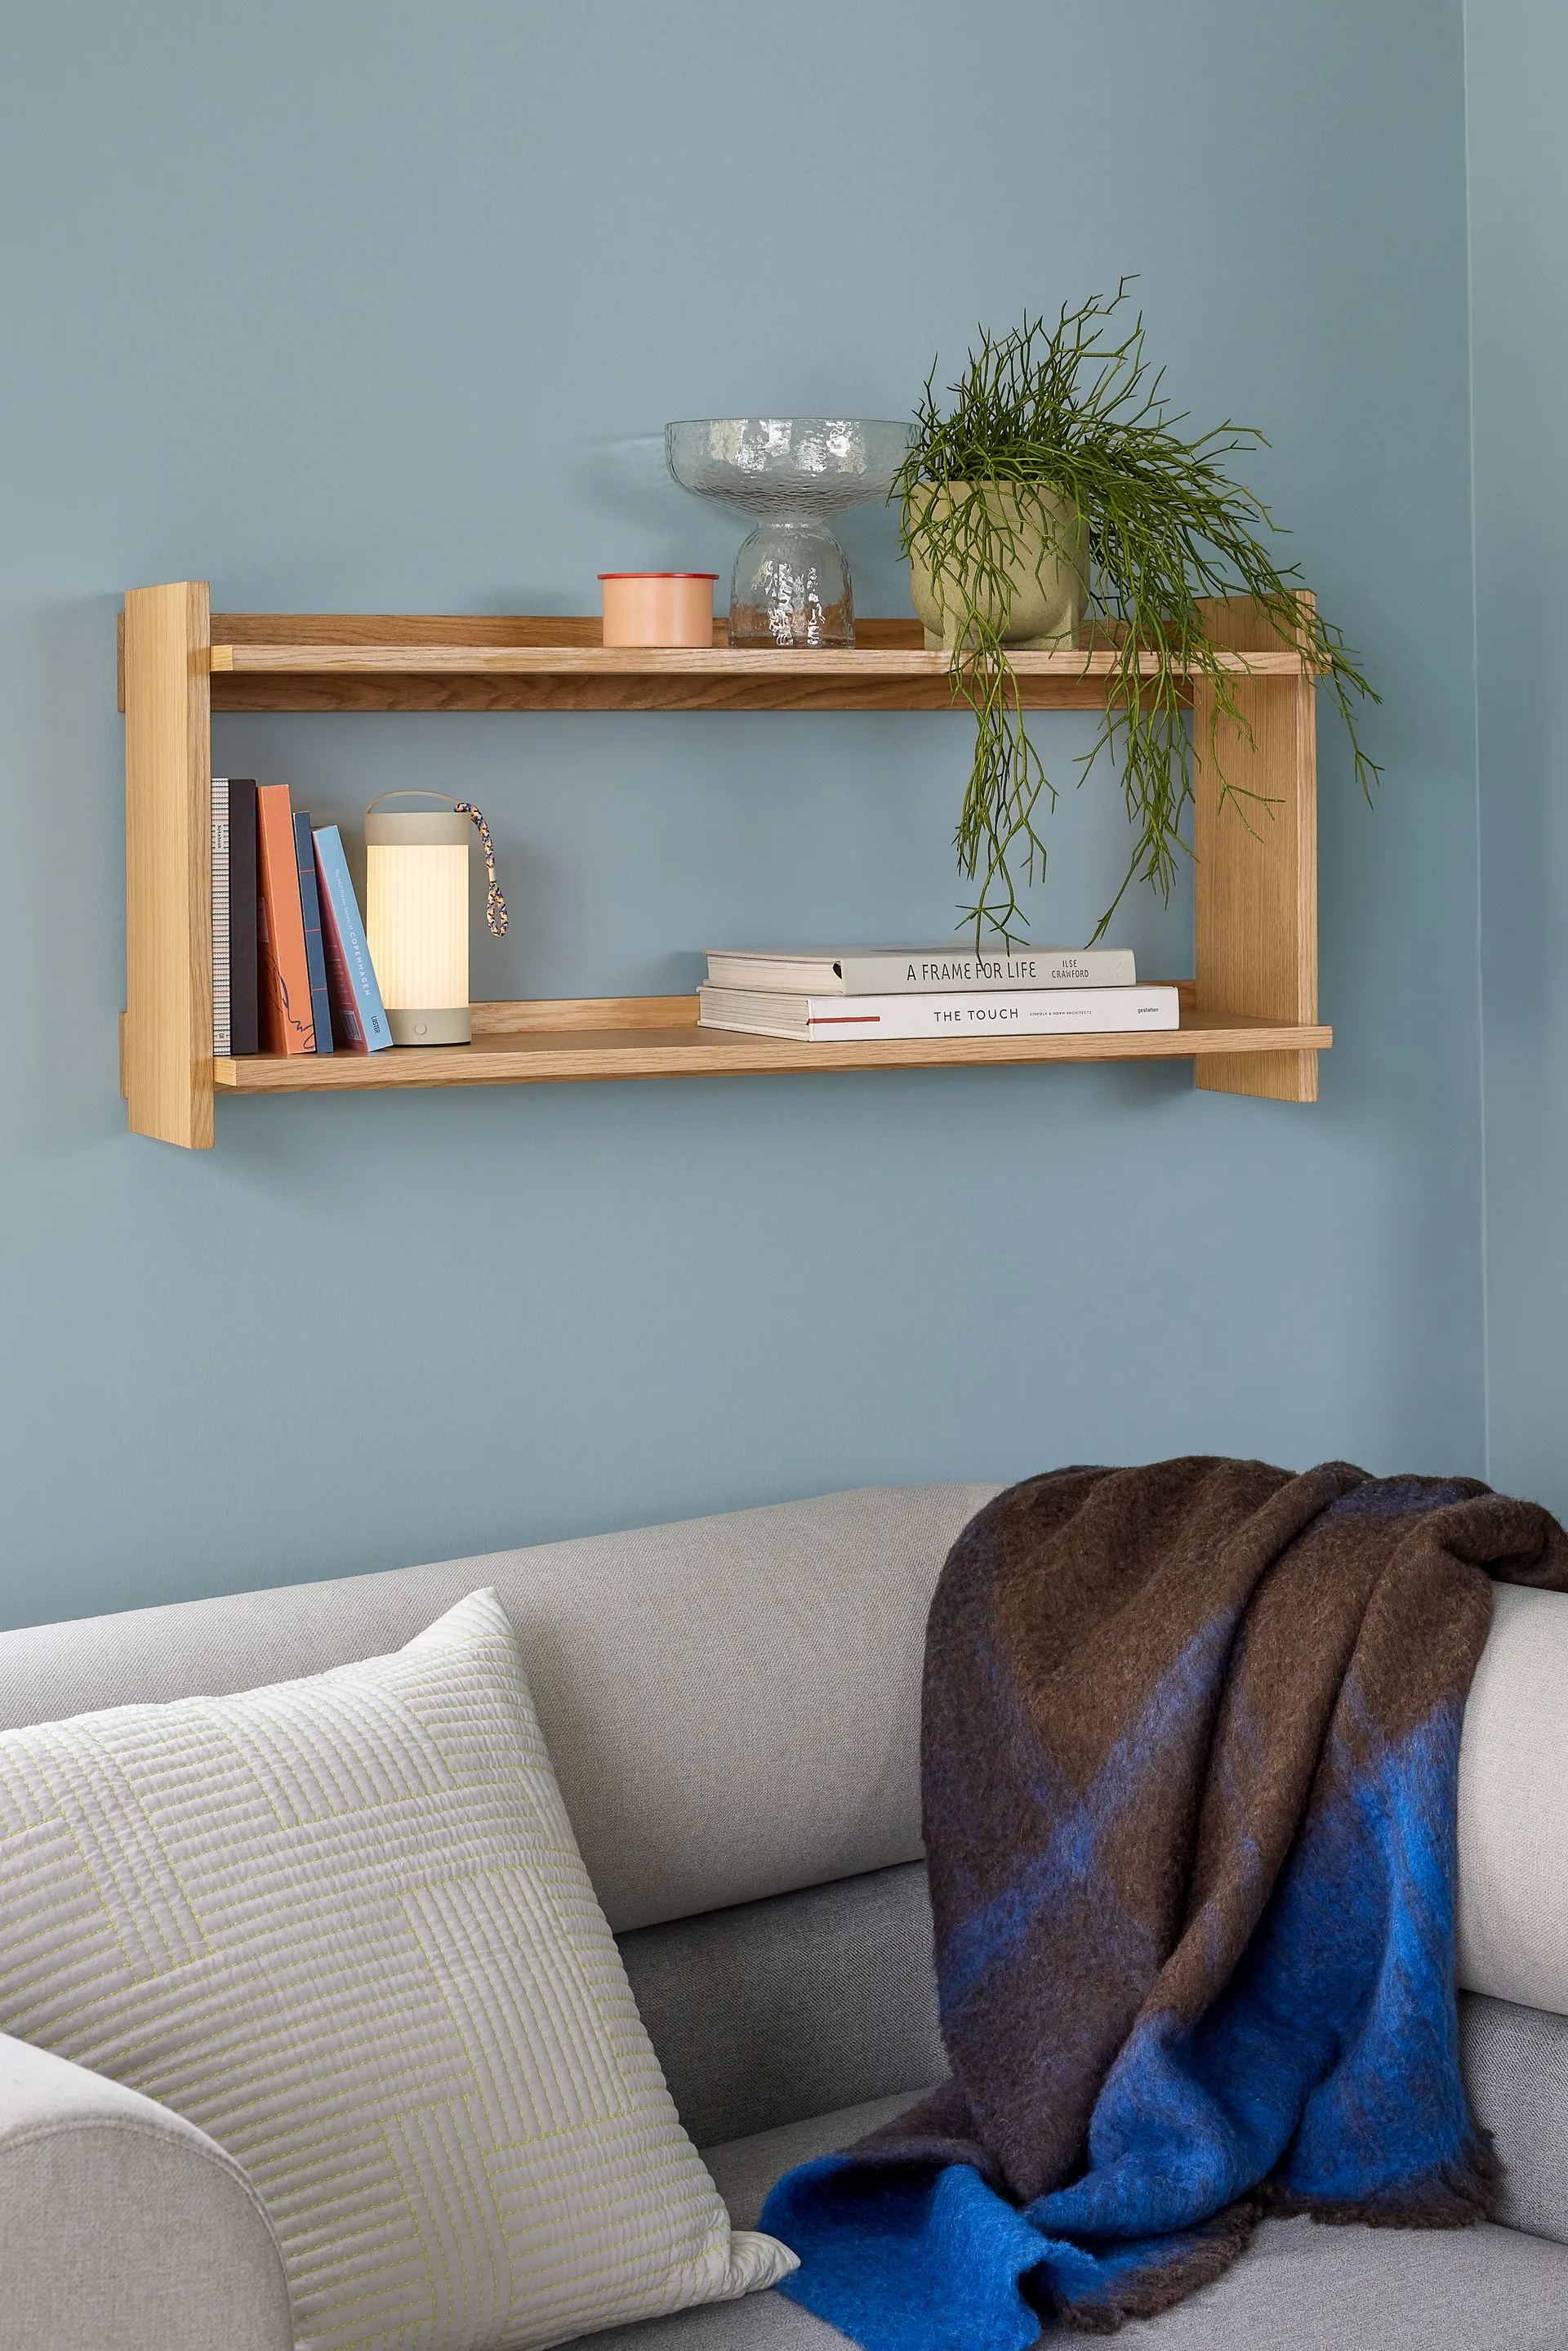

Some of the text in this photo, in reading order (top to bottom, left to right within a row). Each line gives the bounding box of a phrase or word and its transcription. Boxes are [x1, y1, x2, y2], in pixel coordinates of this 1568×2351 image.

[350, 931, 371, 997] COPENHAGEN
[906, 961, 1037, 981] A FRAME FOR LIFE
[1062, 959, 1077, 968] ILSE
[1051, 969, 1089, 979] CRAWFORD
[933, 1008, 1018, 1022] THE TOUCH
[371, 1015, 381, 1034] LUSTER
